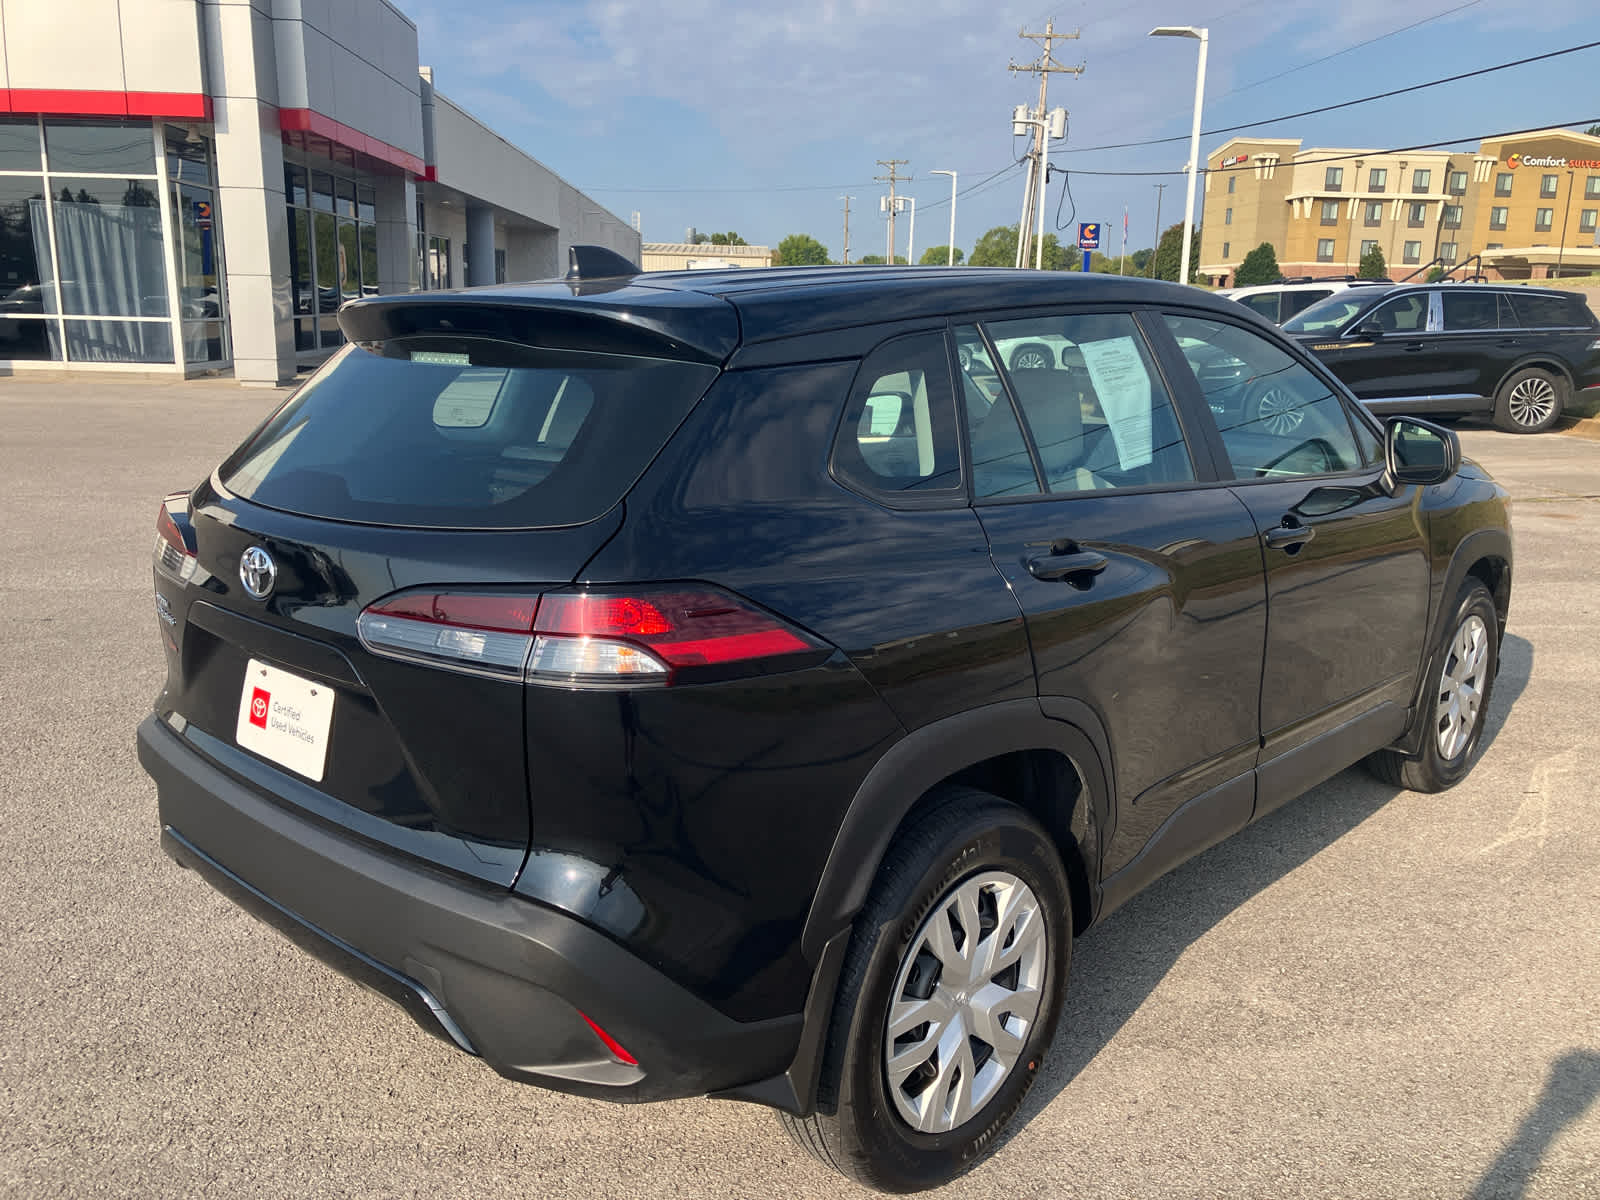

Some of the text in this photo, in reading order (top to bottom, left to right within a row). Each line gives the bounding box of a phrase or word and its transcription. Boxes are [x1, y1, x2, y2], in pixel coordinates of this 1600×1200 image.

[1523, 155, 1566, 167] Comfort
[273, 701, 301, 721] Certified
[271, 716, 315, 744] Used Vehicles
